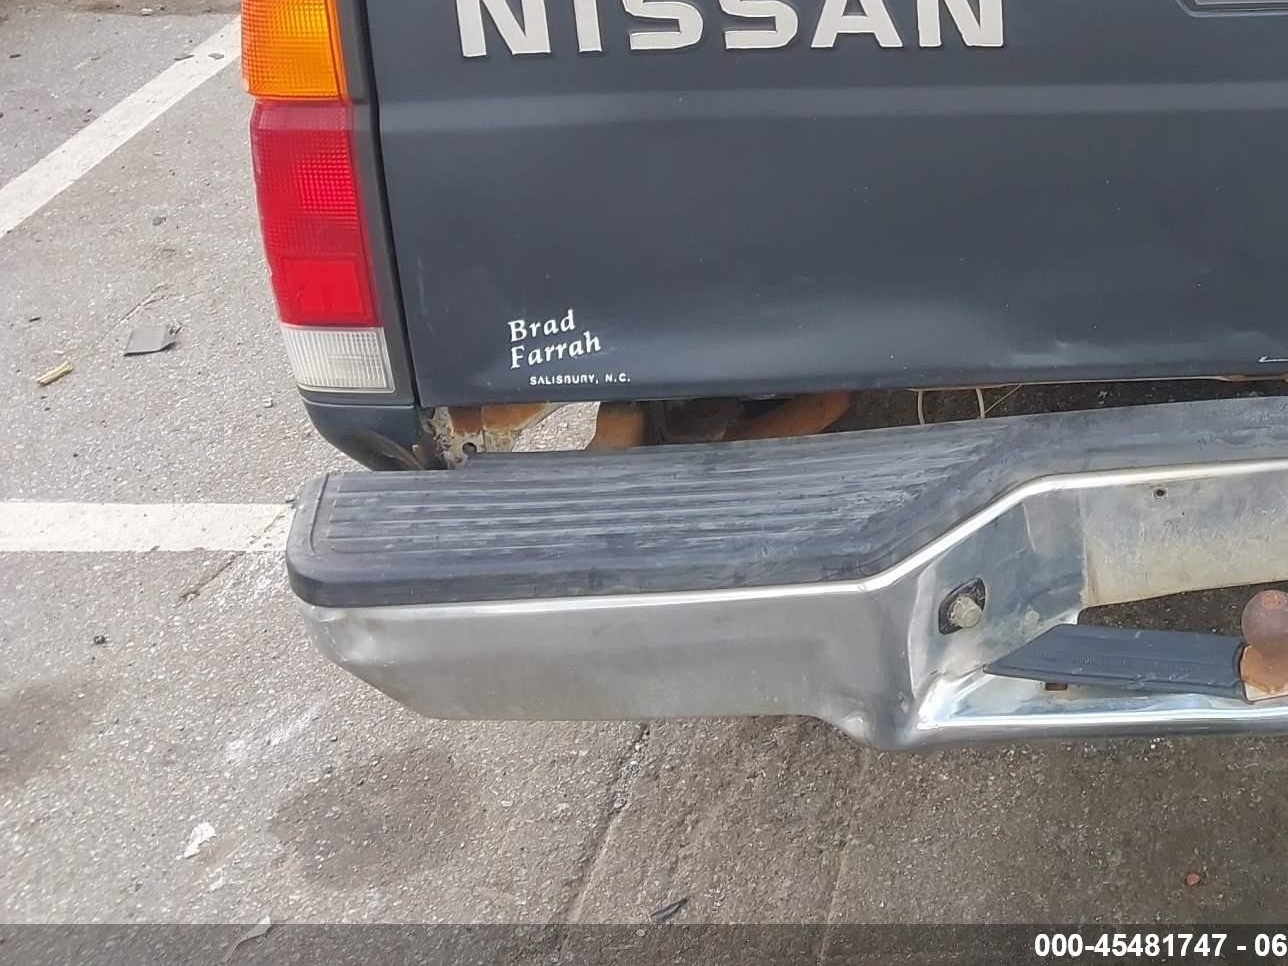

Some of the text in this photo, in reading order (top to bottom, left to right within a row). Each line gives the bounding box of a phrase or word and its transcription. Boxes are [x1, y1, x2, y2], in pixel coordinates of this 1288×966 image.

[508, 309, 576, 342] Brad
[510, 331, 602, 370] Farrah
[530, 373, 631, 386] SALISBURY, N.C.
